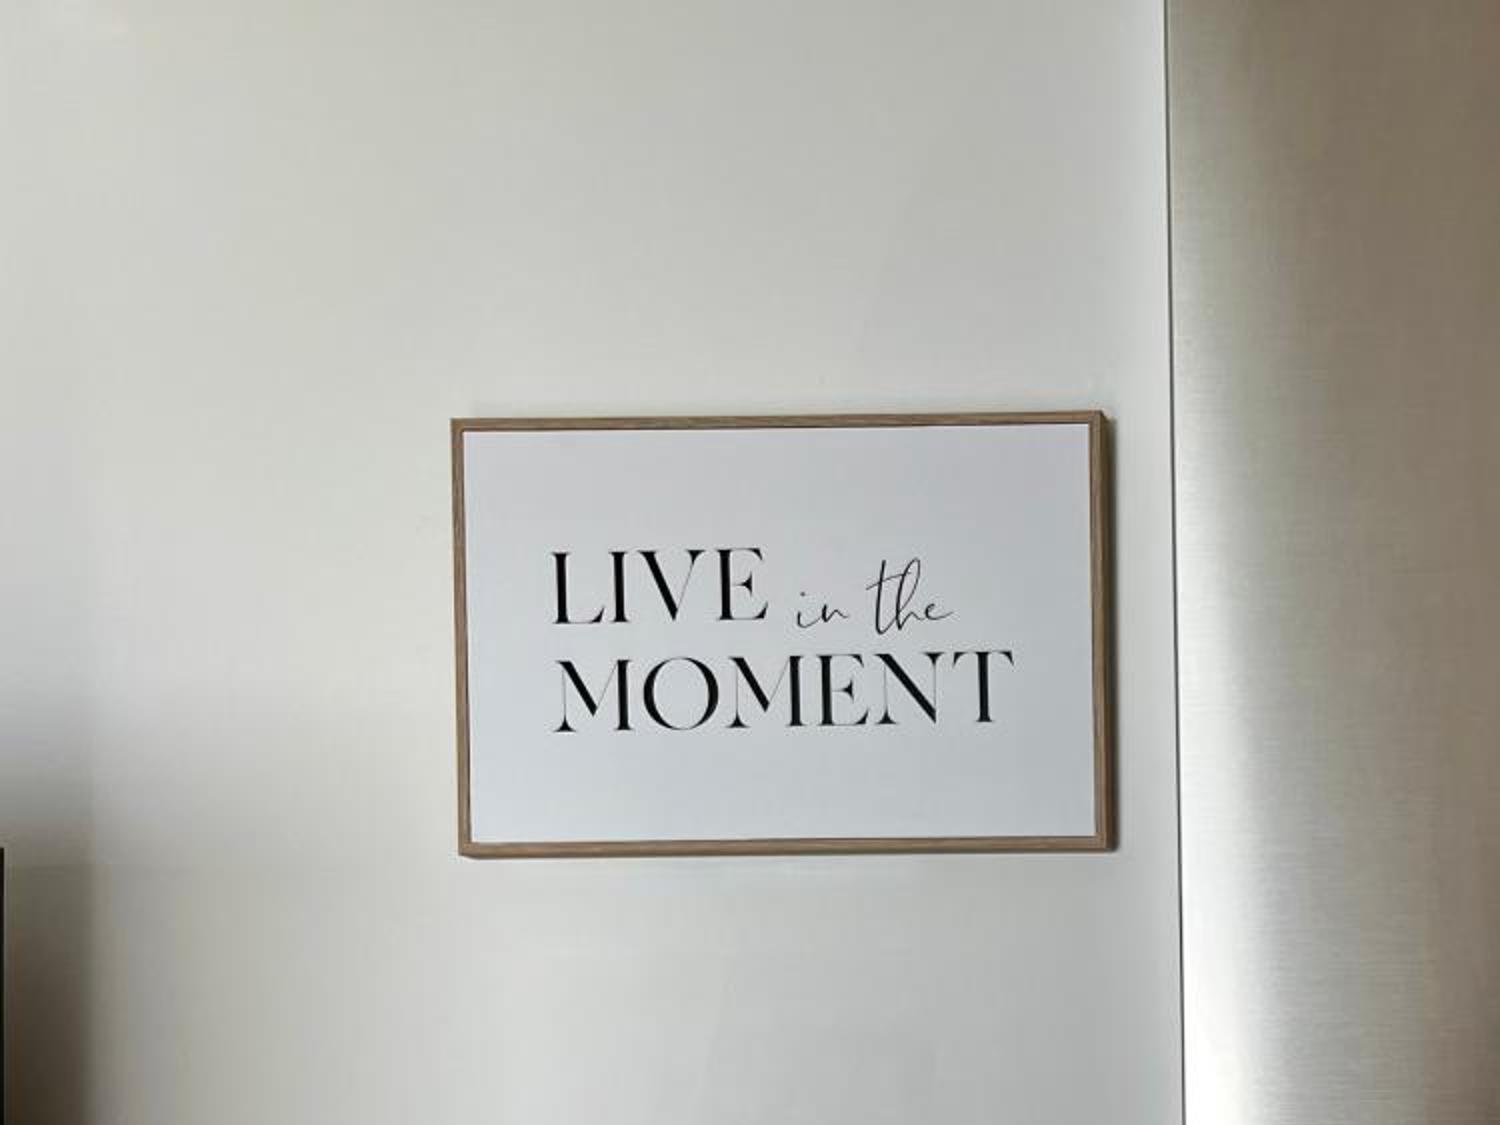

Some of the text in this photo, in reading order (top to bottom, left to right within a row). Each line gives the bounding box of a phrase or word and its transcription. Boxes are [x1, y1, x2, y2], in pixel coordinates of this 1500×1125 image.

[552, 547, 955, 636] LIVE in the
[553, 649, 1014, 733] MOMENT
